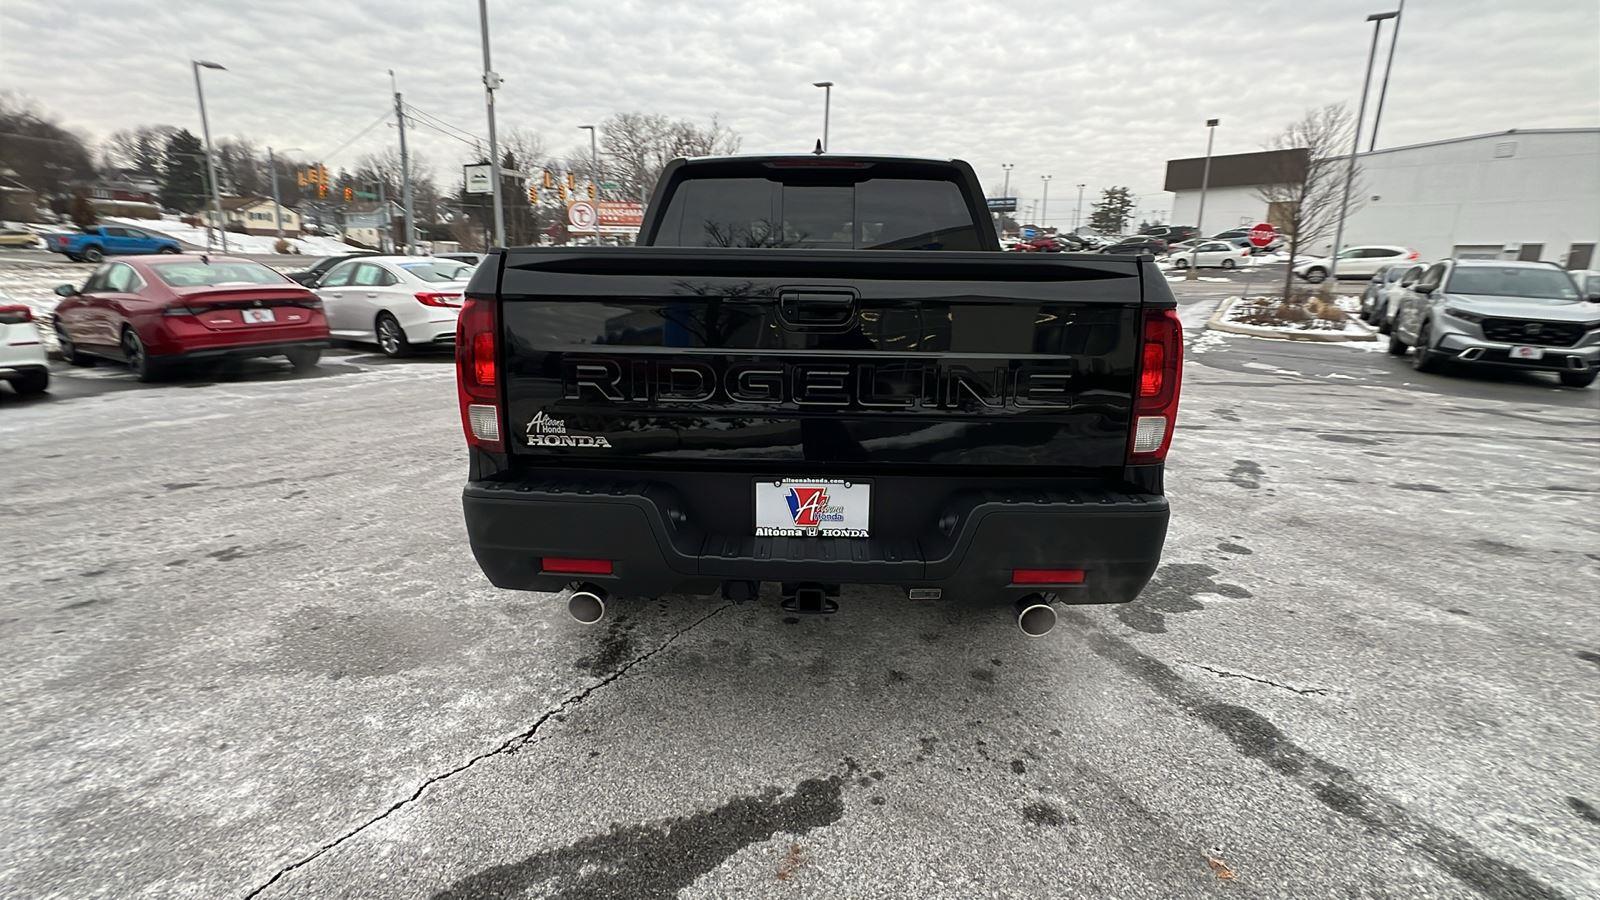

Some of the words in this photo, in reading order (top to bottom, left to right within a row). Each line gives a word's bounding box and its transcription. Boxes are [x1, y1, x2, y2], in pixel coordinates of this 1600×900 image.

[1249, 230, 1274, 240] STOP
[563, 356, 1072, 408] RIDGELINE
[542, 425, 566, 433] Honda
[526, 434, 612, 448] HONDA
[814, 512, 844, 521] Honda
[755, 526, 803, 537] Altoona
[822, 529, 870, 538] HONDA
